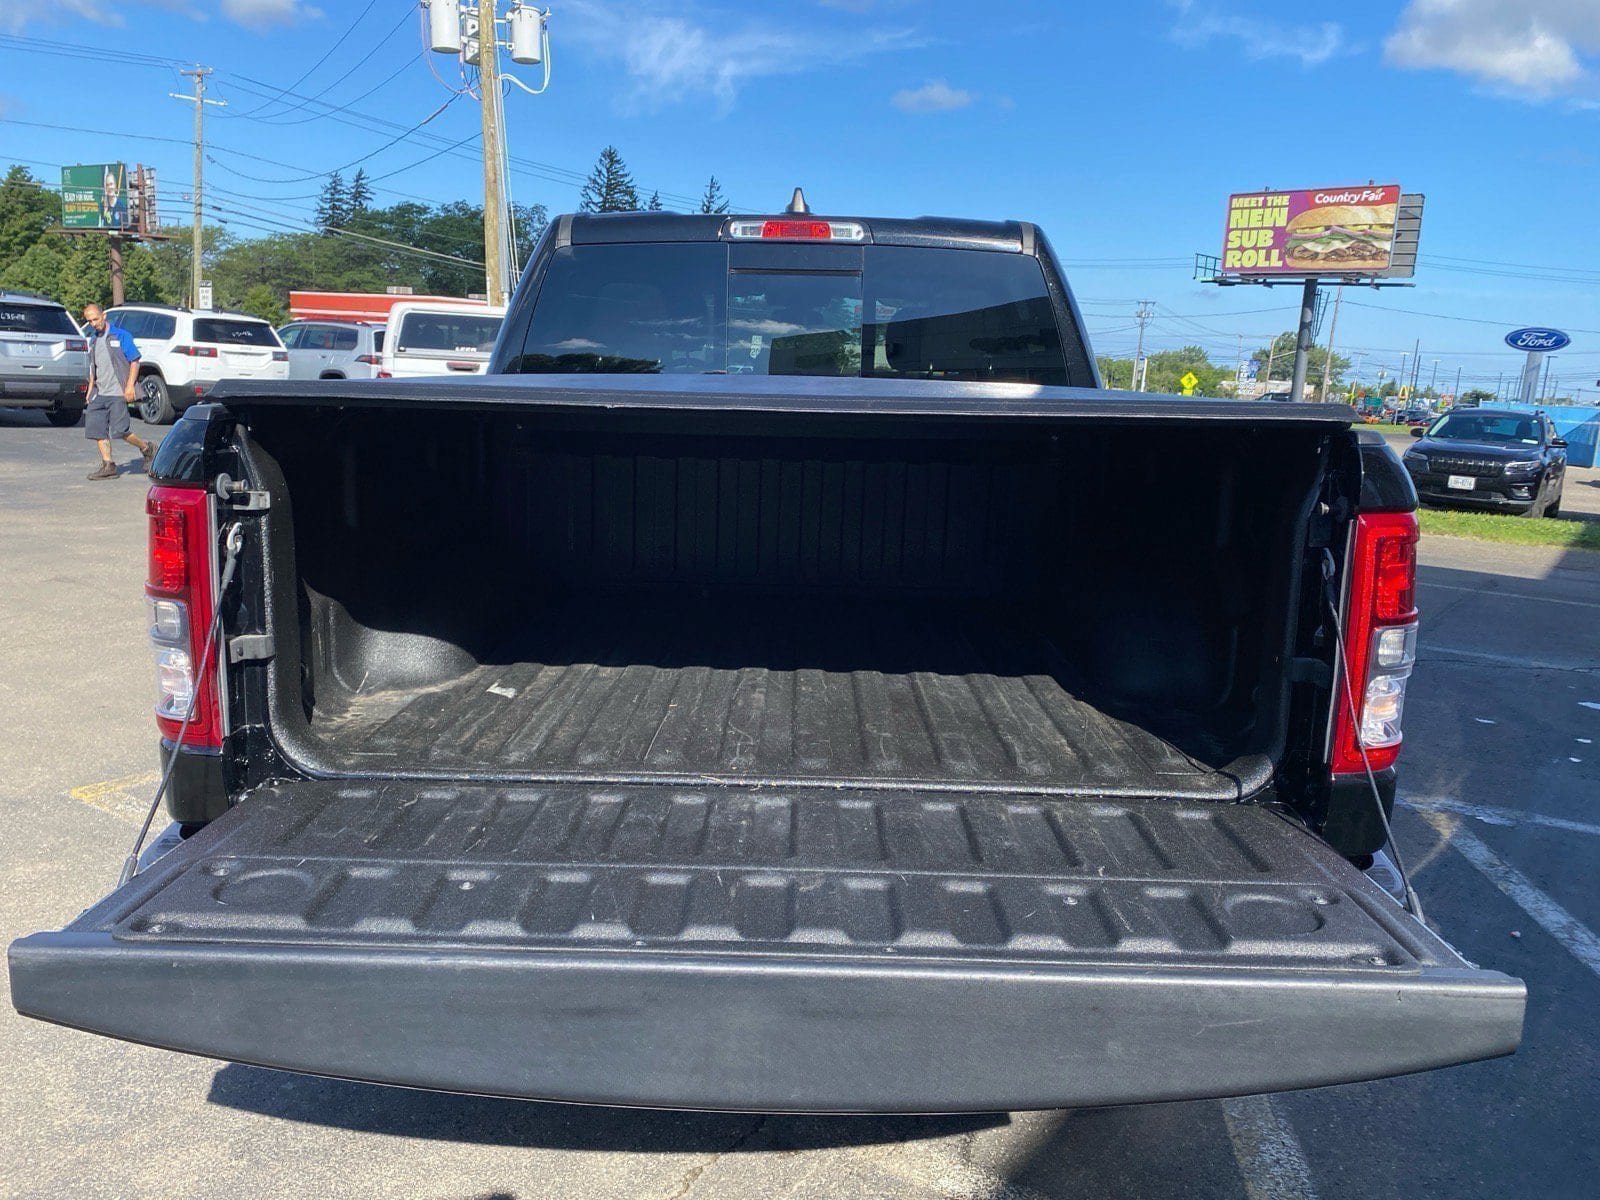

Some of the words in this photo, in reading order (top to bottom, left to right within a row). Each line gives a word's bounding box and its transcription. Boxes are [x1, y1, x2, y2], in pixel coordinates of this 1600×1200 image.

[1231, 197, 1265, 208] MEET
[1266, 195, 1290, 206] THE
[1314, 191, 1361, 204] Country
[1360, 188, 1385, 202] Fair
[1229, 207, 1289, 229] NEW
[1227, 229, 1274, 248] SUB
[1225, 249, 1283, 268] ROLL
[1517, 331, 1557, 347] Ford
